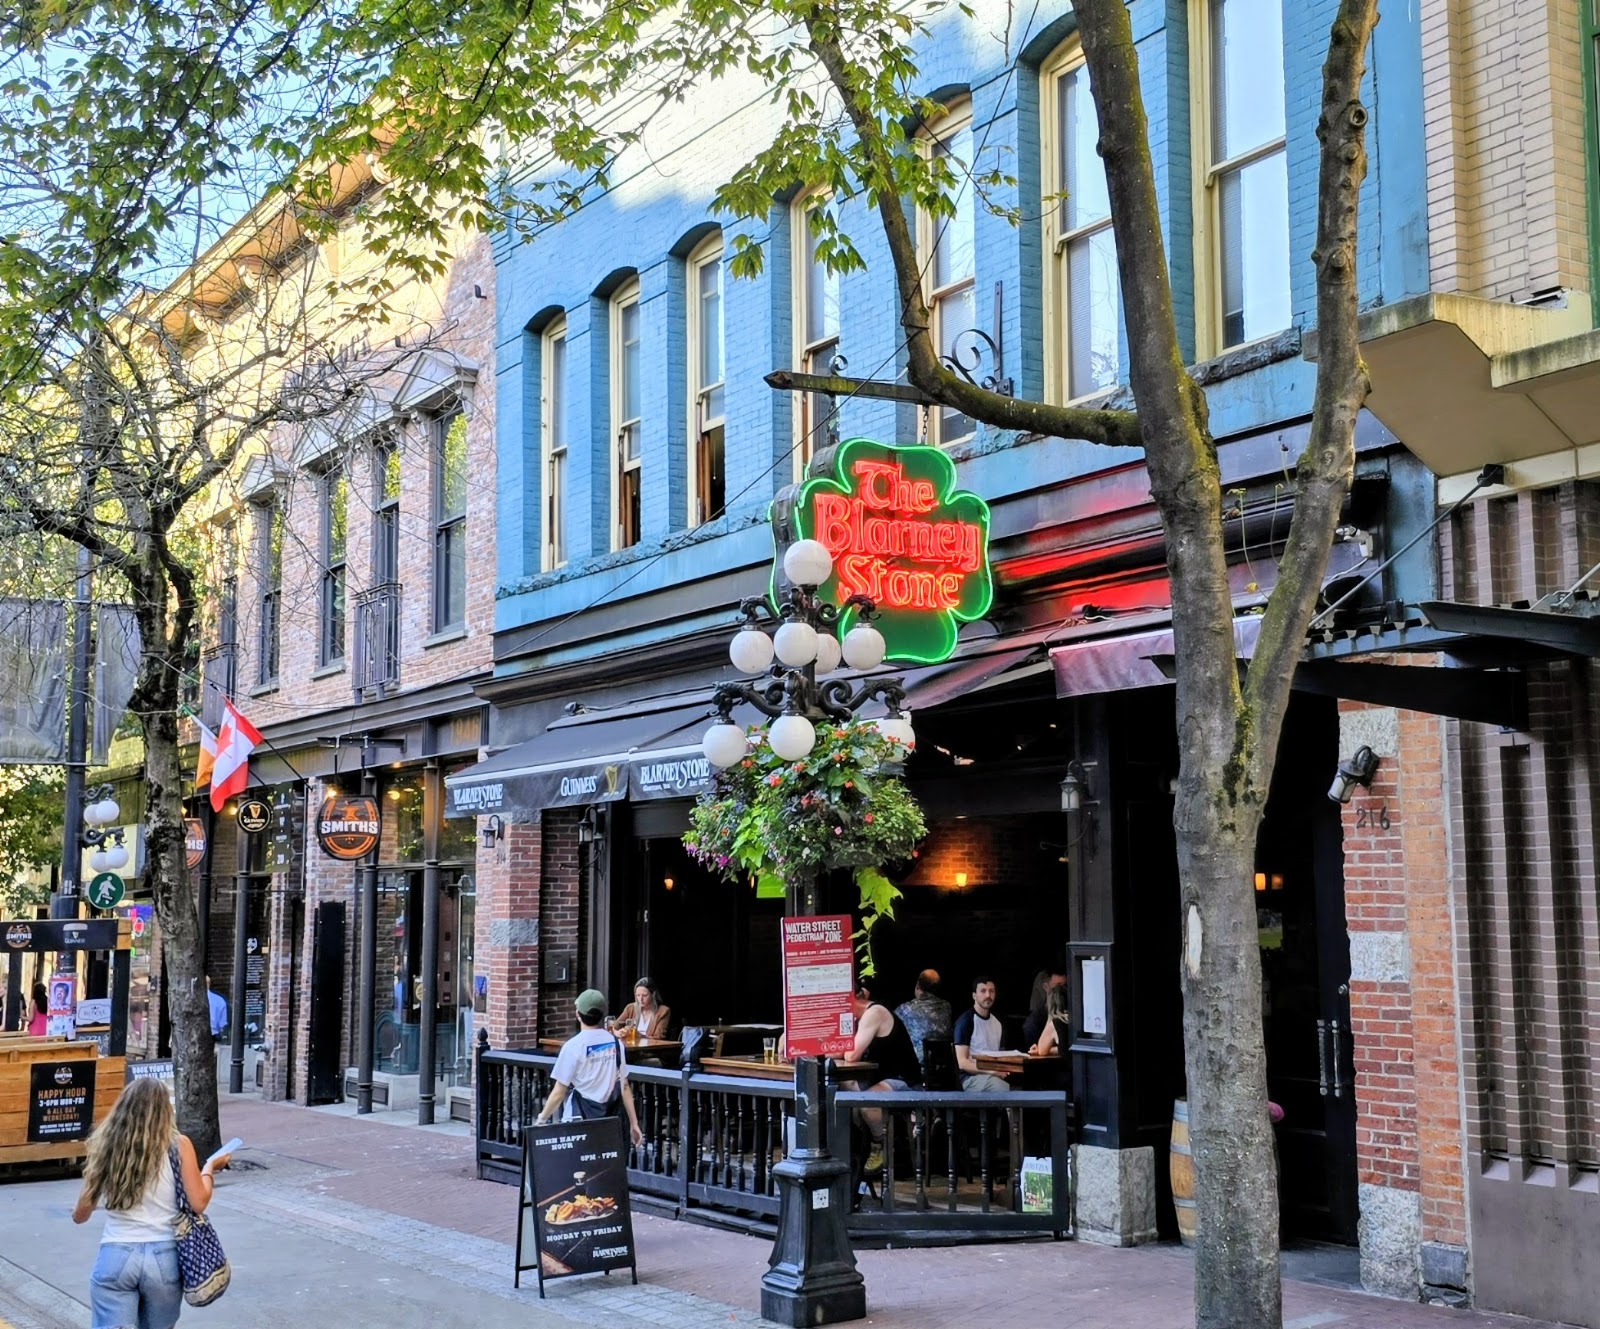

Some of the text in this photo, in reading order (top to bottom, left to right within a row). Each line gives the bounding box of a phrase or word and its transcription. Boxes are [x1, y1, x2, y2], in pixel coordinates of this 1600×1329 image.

[853, 459, 939, 513] The
[814, 493, 981, 573] Blarney
[837, 553, 965, 609] Stone
[560, 775, 598, 796] GUINNESS
[1355, 806, 1391, 830] 216
[320, 820, 379, 834] SMITHS
[785, 919, 841, 935] WATER STREET
[6, 932, 32, 940] SMITHS
[786, 930, 842, 943] PEDESTRIAN ZONE
[38, 1087, 87, 1100] HAPPY HOUR
[60, 1097, 85, 1106] MON-FRI
[64, 1106, 77, 1114] DAY
[535, 1133, 588, 1147] IRISH HAPPY
[551, 1142, 573, 1151] HOUR
[546, 1231, 580, 1242] MONDAY
[593, 1225, 623, 1236] FRIDAY
